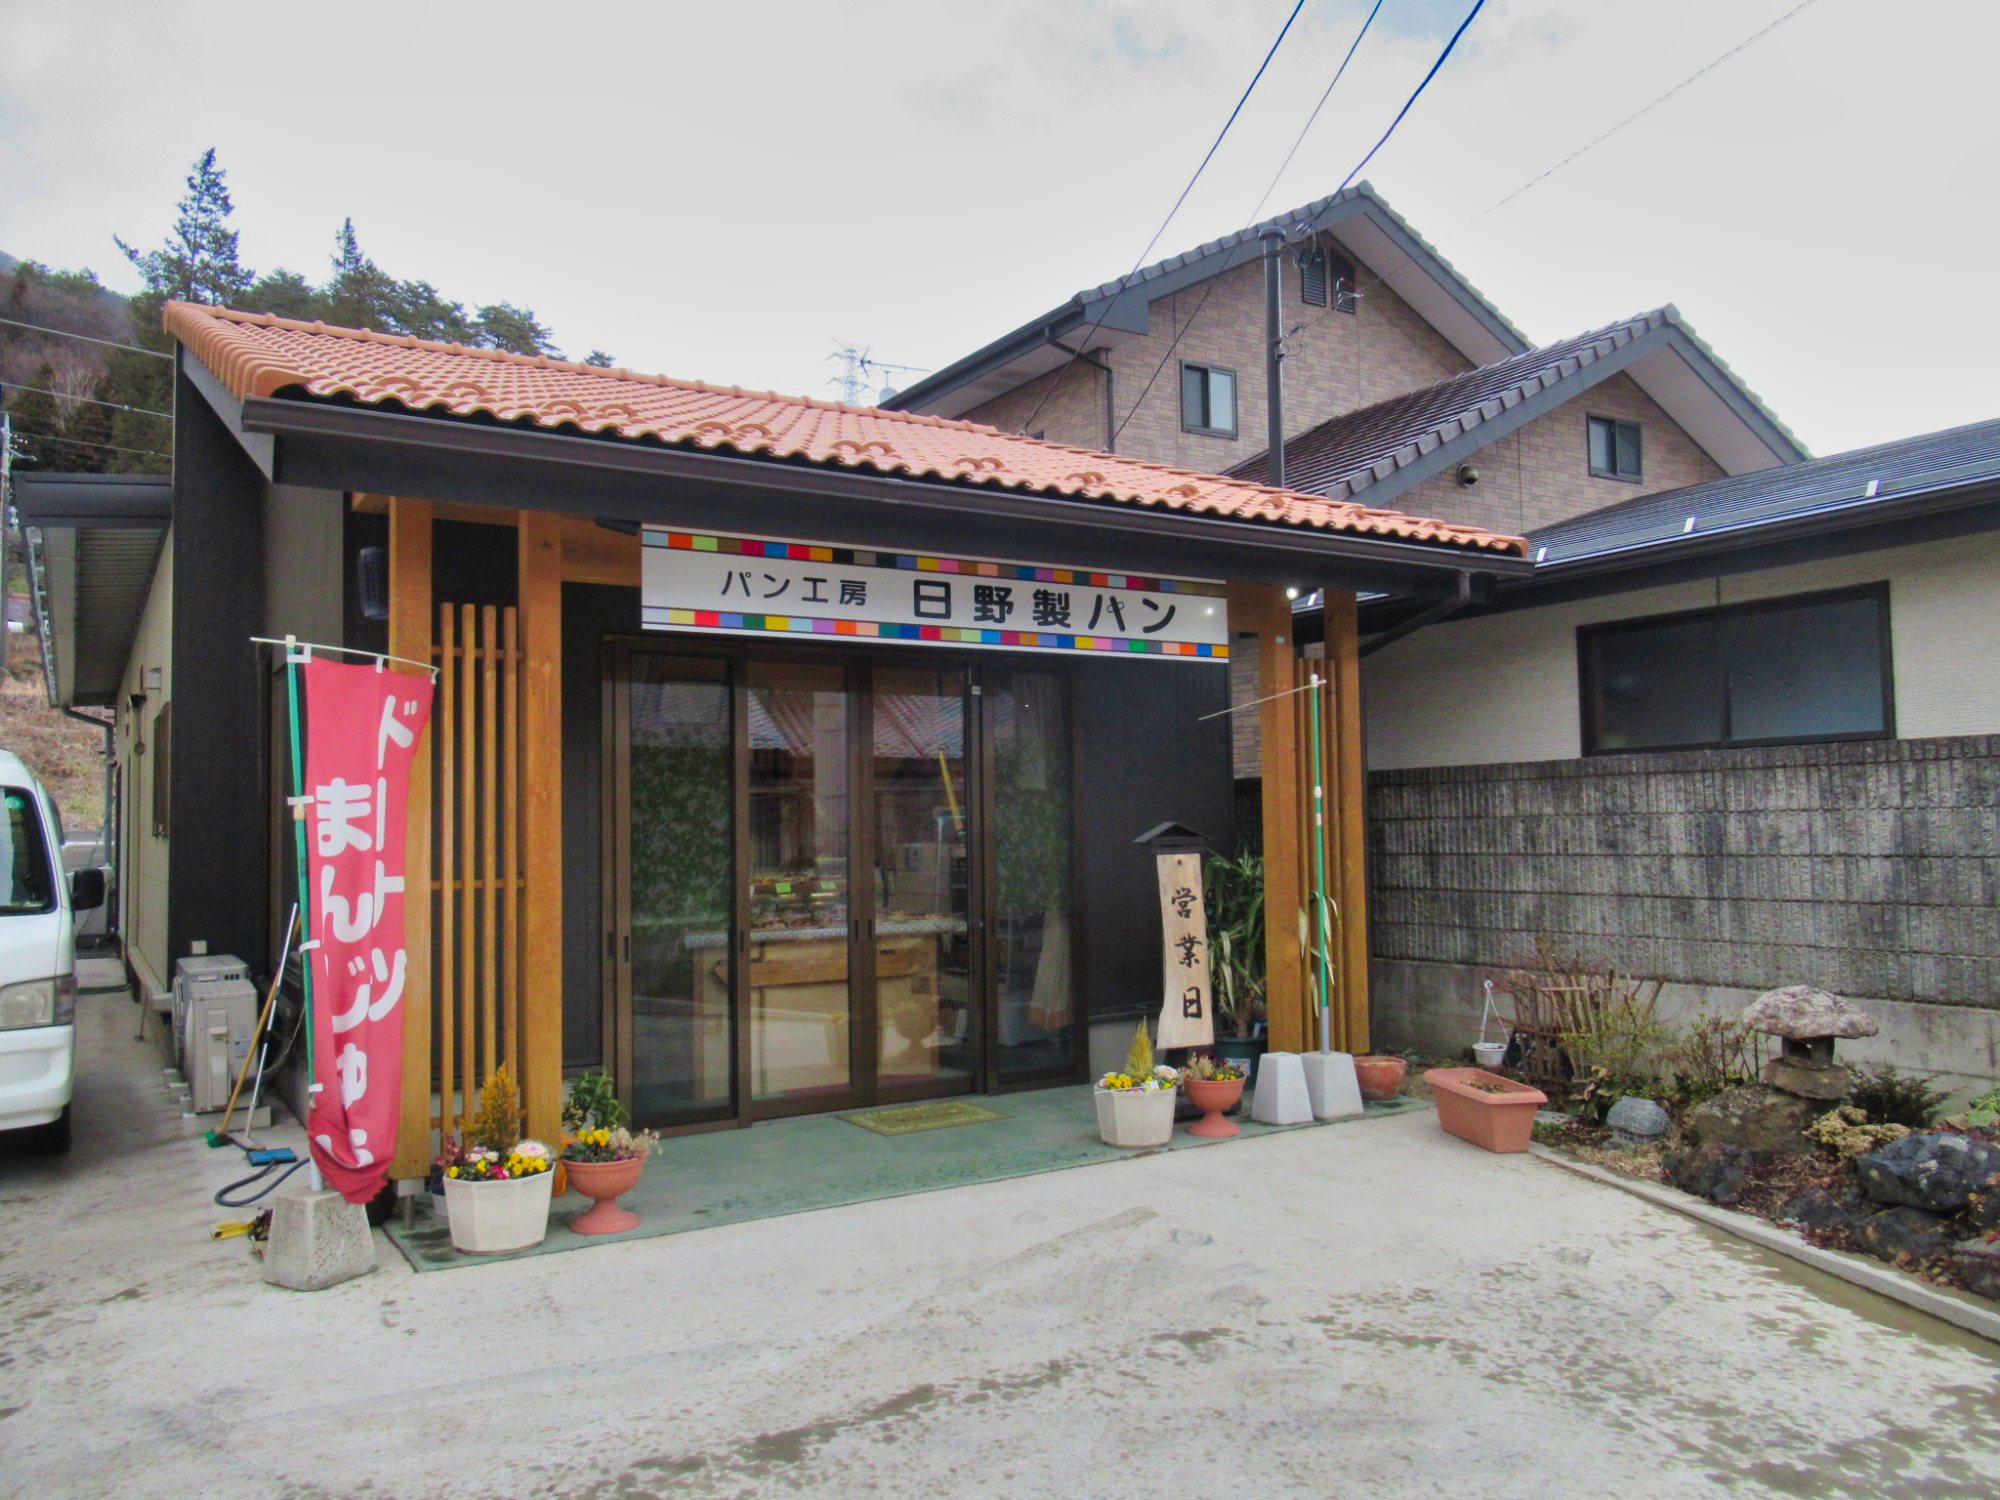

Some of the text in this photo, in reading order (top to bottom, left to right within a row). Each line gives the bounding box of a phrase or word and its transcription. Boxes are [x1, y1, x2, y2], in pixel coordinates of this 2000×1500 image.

[720, 570, 1176, 634] パン工房 日野製パン
[1171, 886, 1203, 1019] 営業日
